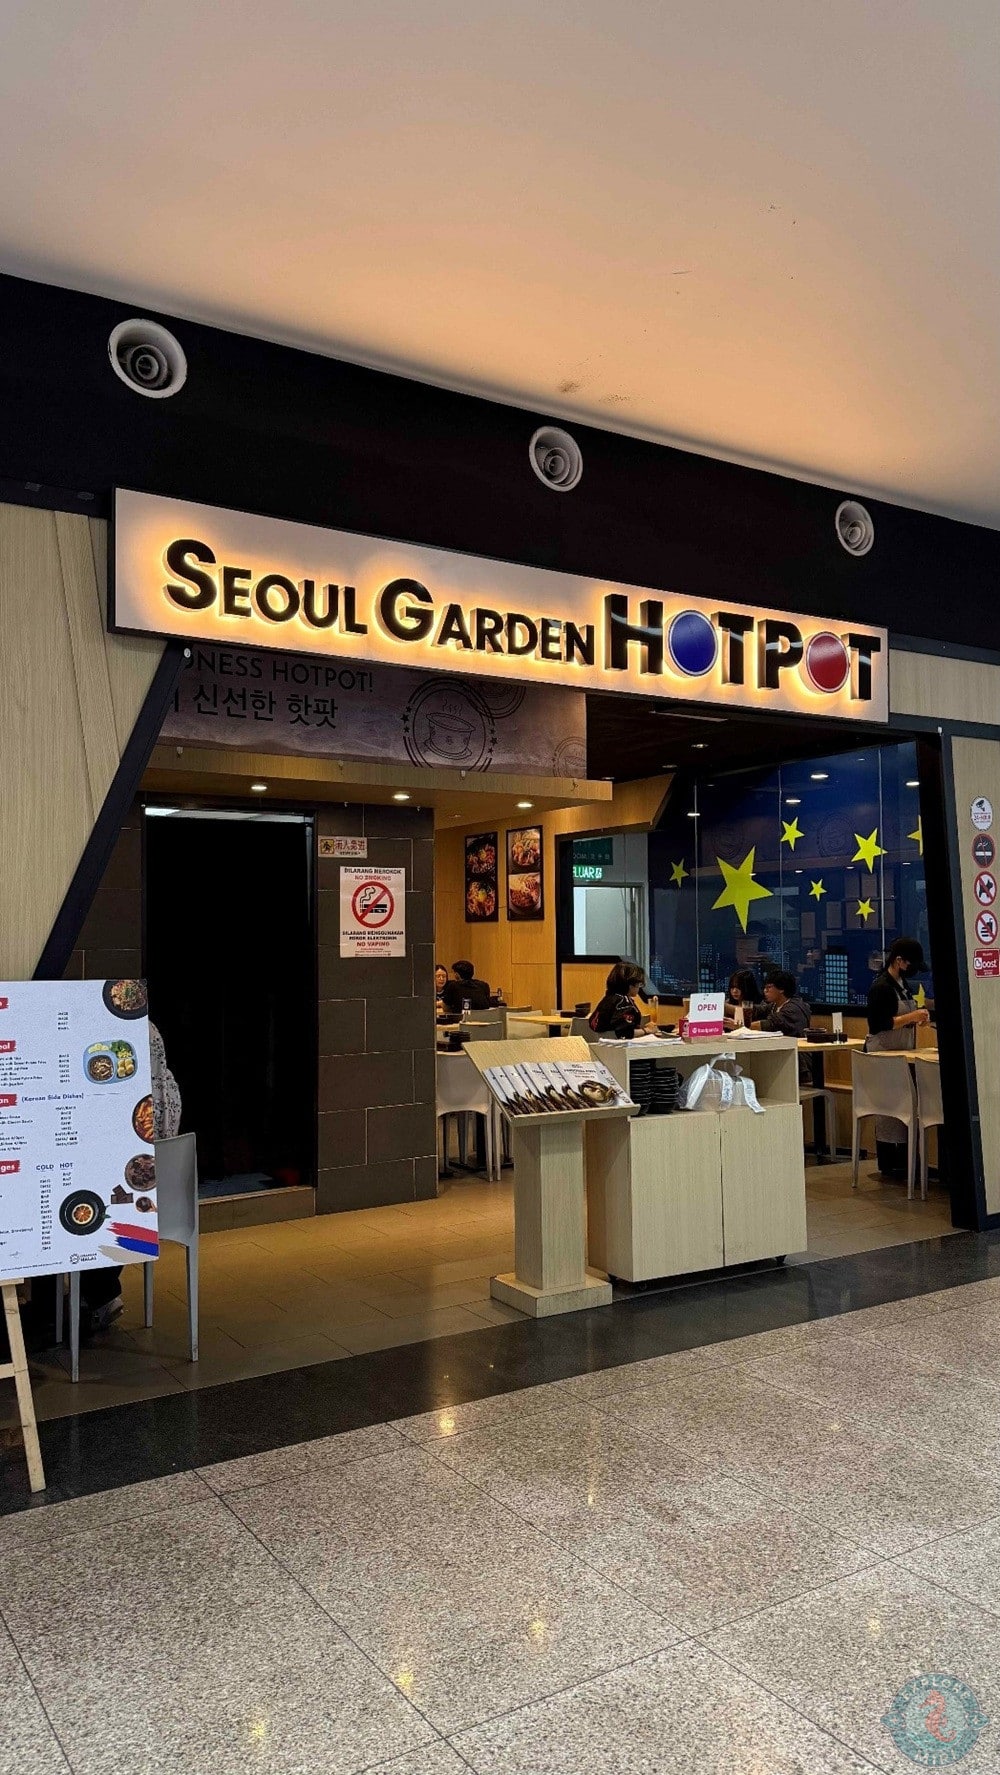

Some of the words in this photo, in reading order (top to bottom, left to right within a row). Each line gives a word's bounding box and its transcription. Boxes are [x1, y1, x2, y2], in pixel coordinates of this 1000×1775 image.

[164, 539, 368, 635] SEOUL
[377, 578, 595, 666] GARDEN
[605, 594, 881, 700] HOTPOT
[272, 660, 373, 692] HOTPOT!
[193, 683, 276, 722] 신선한
[286, 693, 338, 729] 핫팟
[697, 1003, 717, 1012] OPEN
